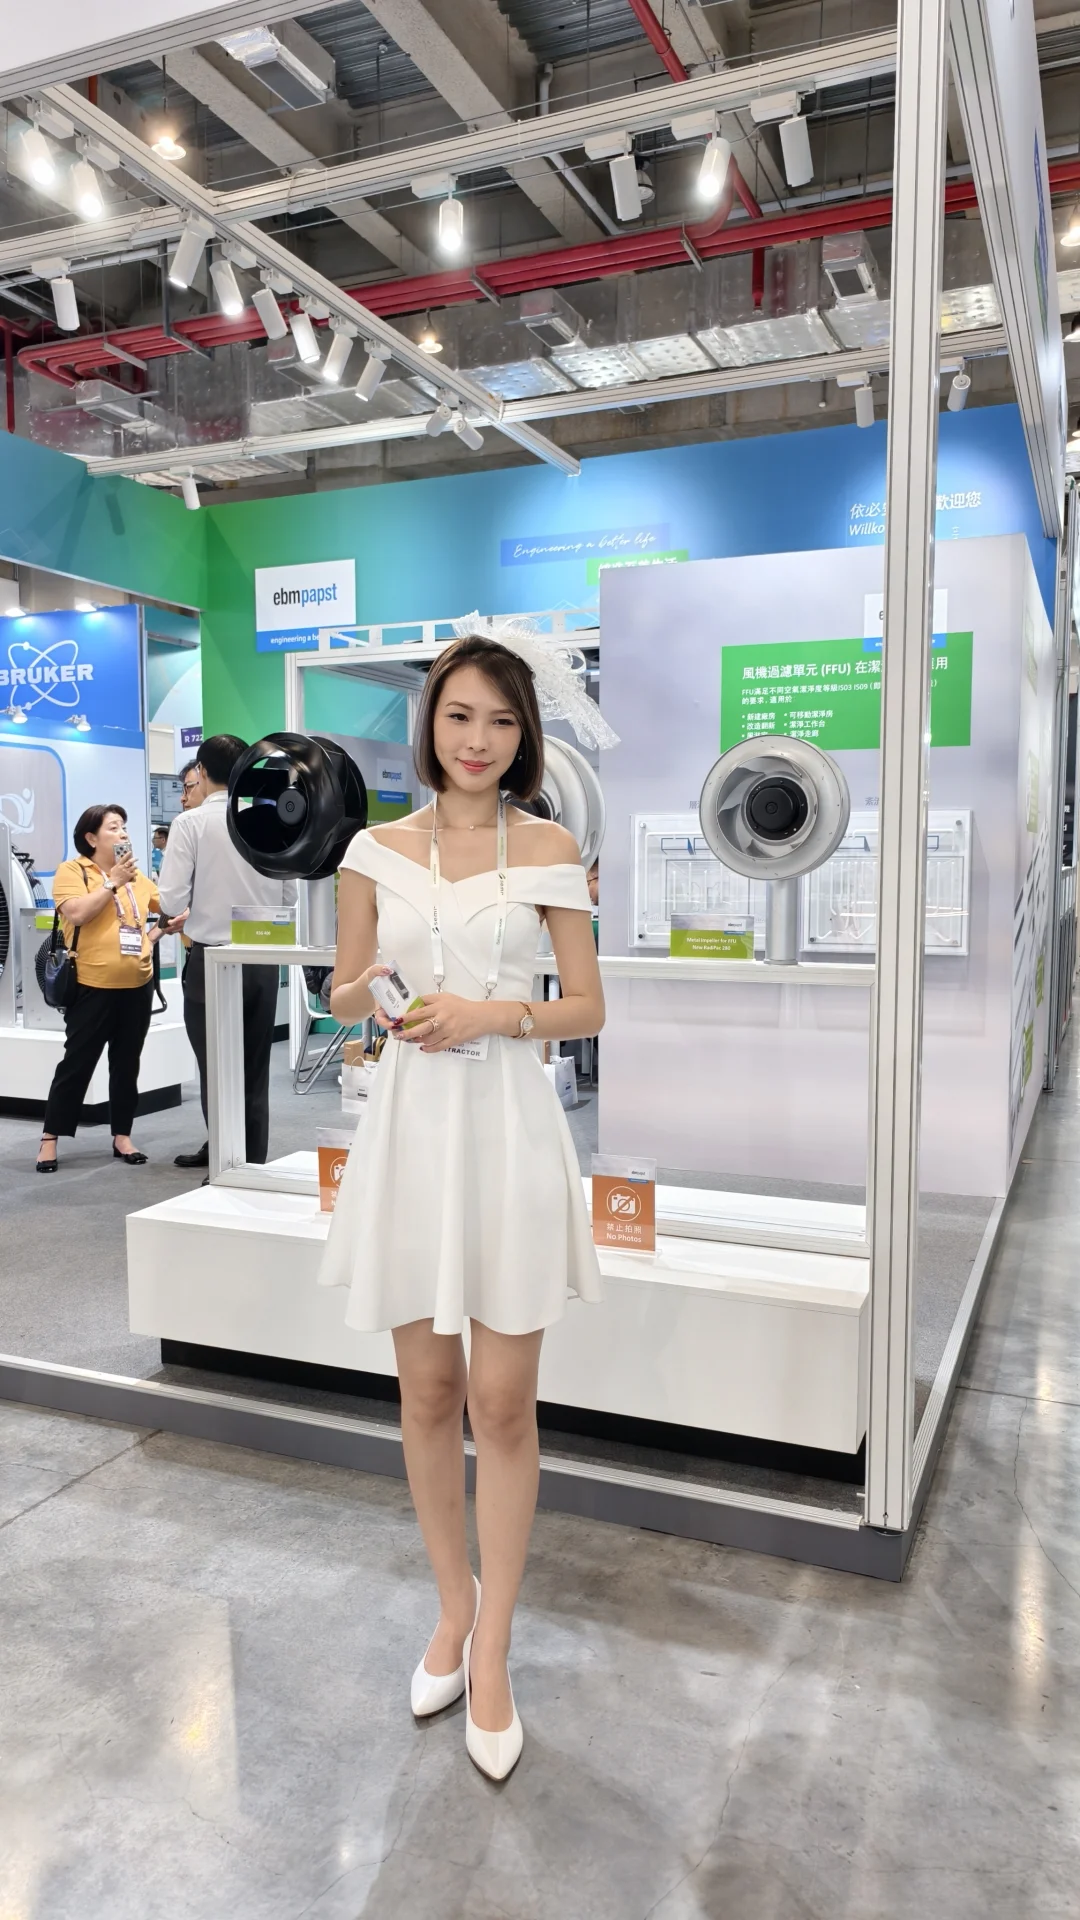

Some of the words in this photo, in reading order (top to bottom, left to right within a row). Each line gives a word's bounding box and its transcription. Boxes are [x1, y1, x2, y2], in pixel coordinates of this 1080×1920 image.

[513, 543, 583, 558] Engineering
[598, 533, 631, 550] better
[634, 532, 657, 549] life
[273, 583, 338, 607] ebmpapst
[270, 634, 307, 646] engineering
[0, 663, 94, 687] BRUKER
[742, 664, 818, 680] 風機過濾單元
[821, 663, 851, 677] (FFU)
[855, 660, 882, 675] 在潔
[184, 735, 190, 743] R
[444, 1047, 481, 1057] TRACTOR
[606, 1222, 642, 1235] 禁止拍照
[606, 1232, 616, 1240] No
[618, 1233, 642, 1243] Photos
